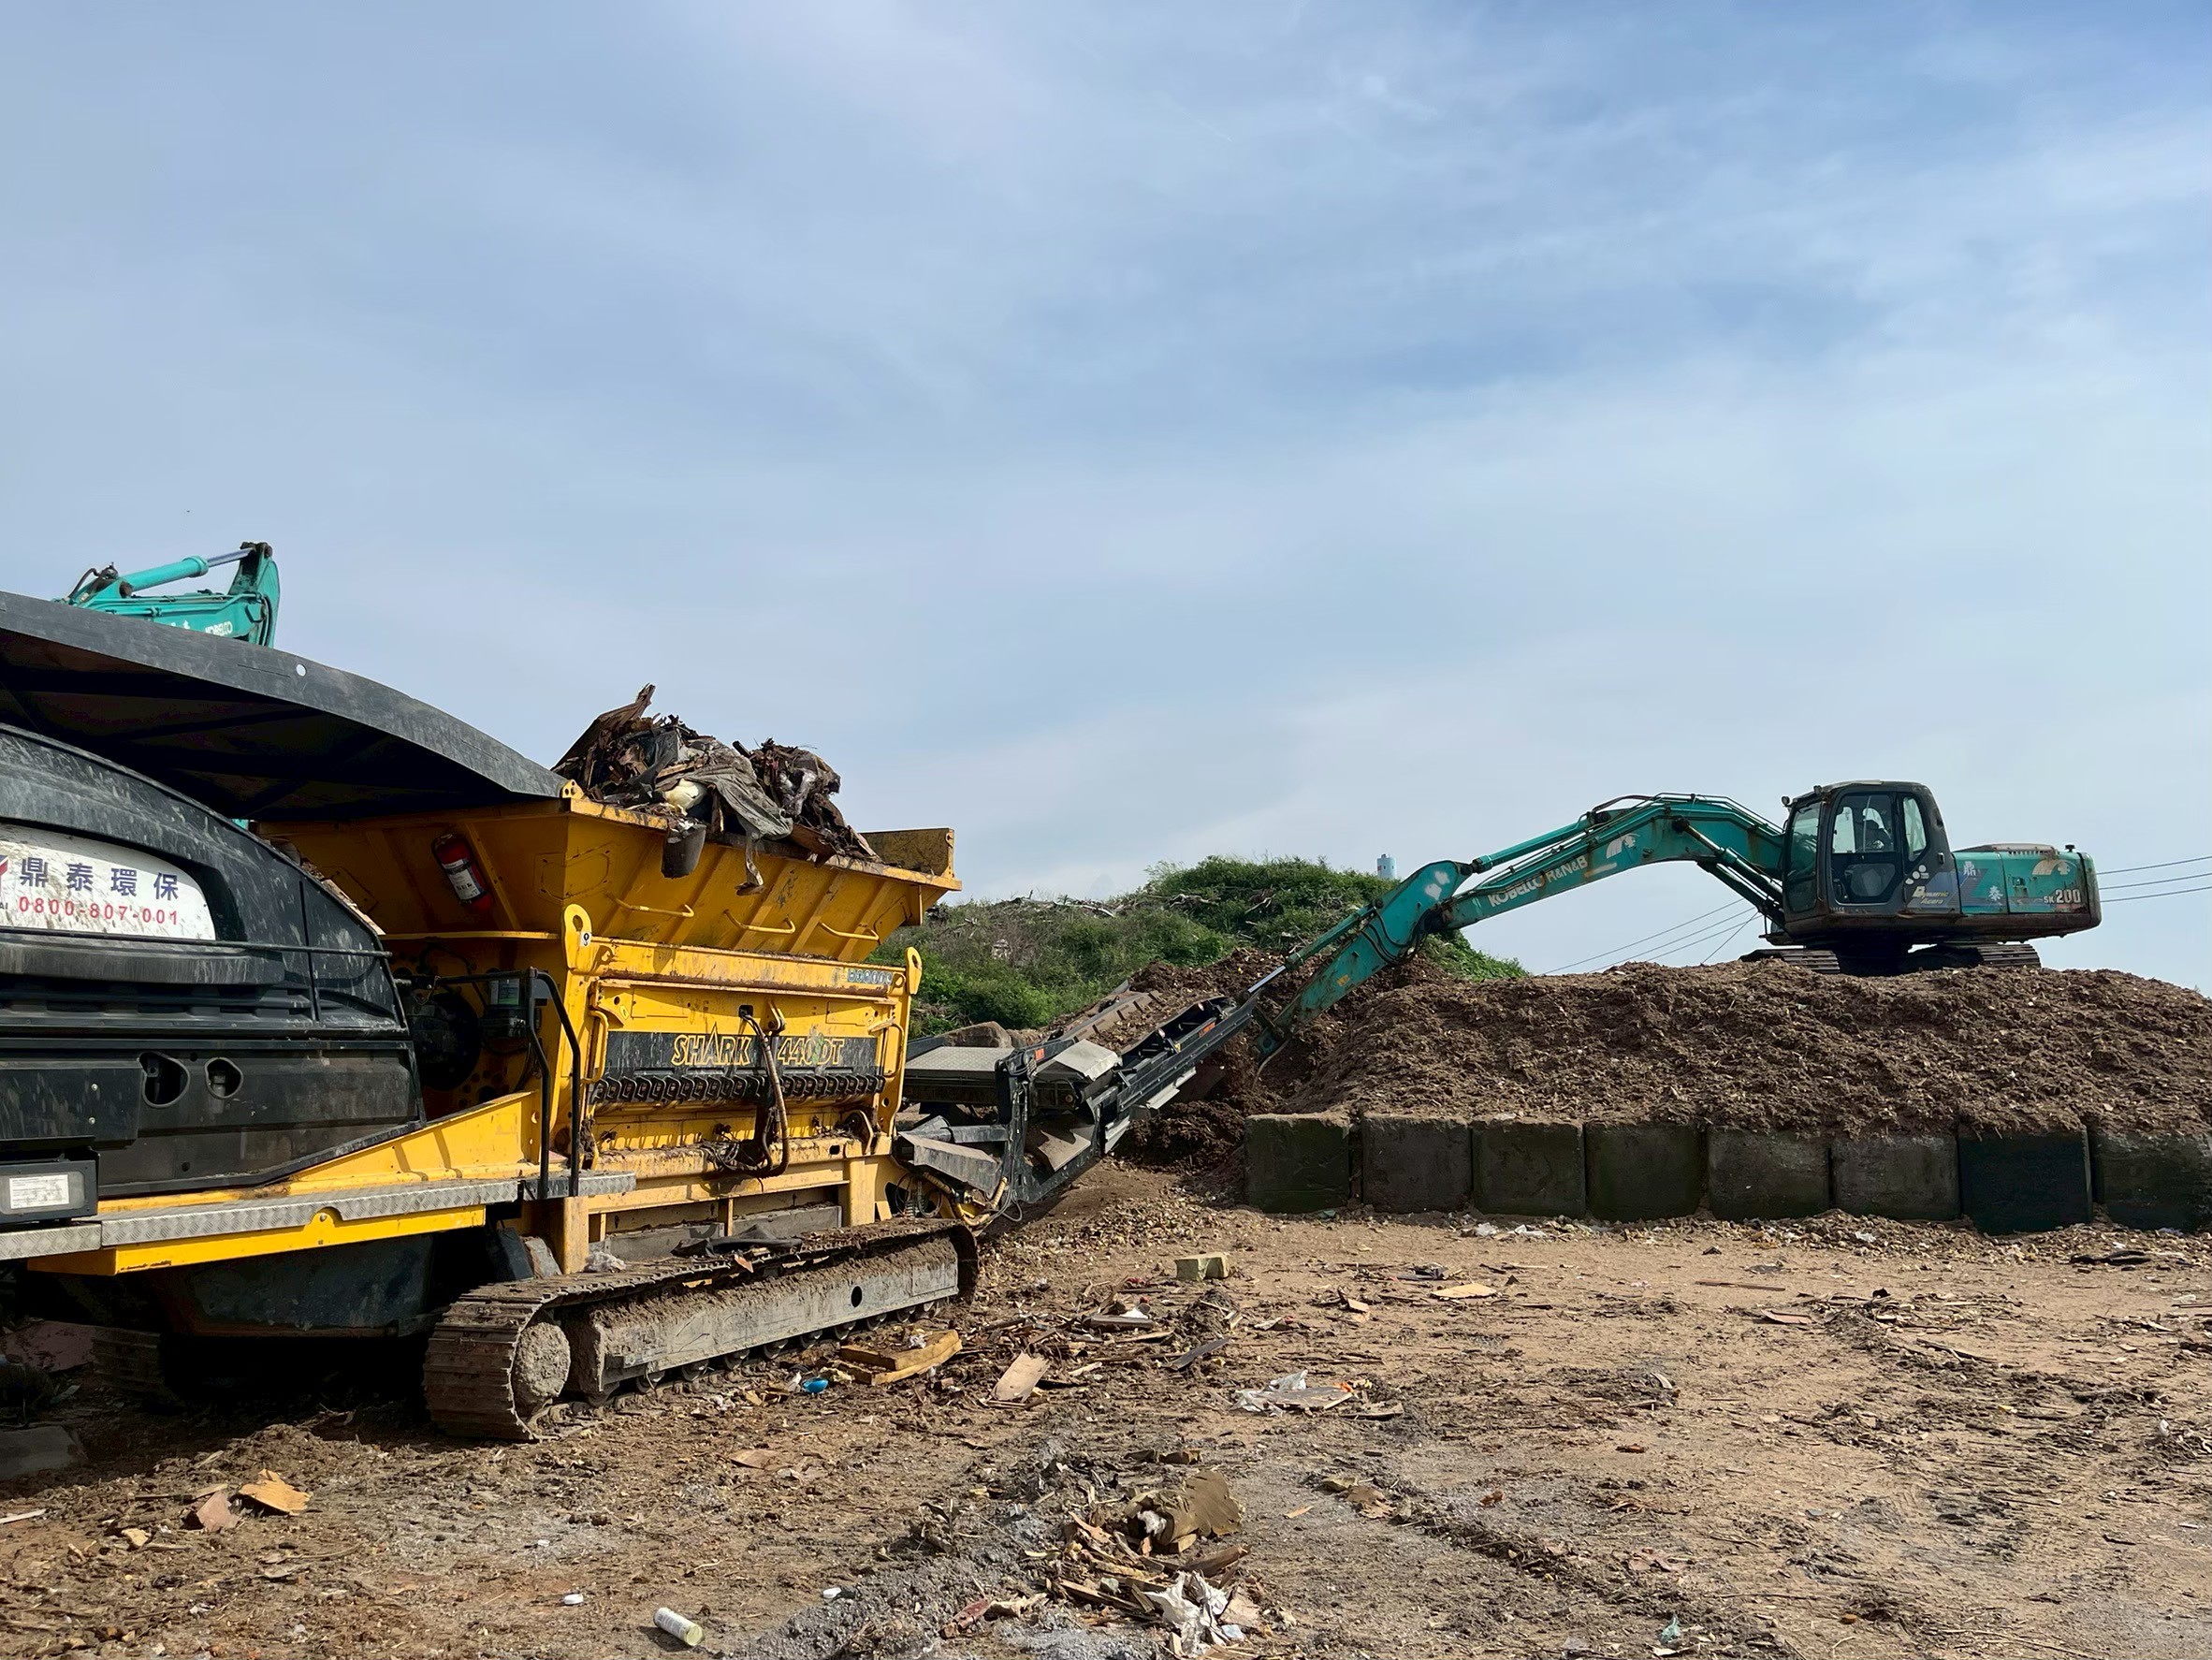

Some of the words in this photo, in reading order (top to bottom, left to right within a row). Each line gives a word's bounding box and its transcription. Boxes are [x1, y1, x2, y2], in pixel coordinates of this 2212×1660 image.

[20, 856, 179, 901] 鼎泰環保
[2055, 889, 2082, 904] 200
[19, 896, 178, 925] 0800-807-001
[672, 1021, 752, 1066] SHARK
